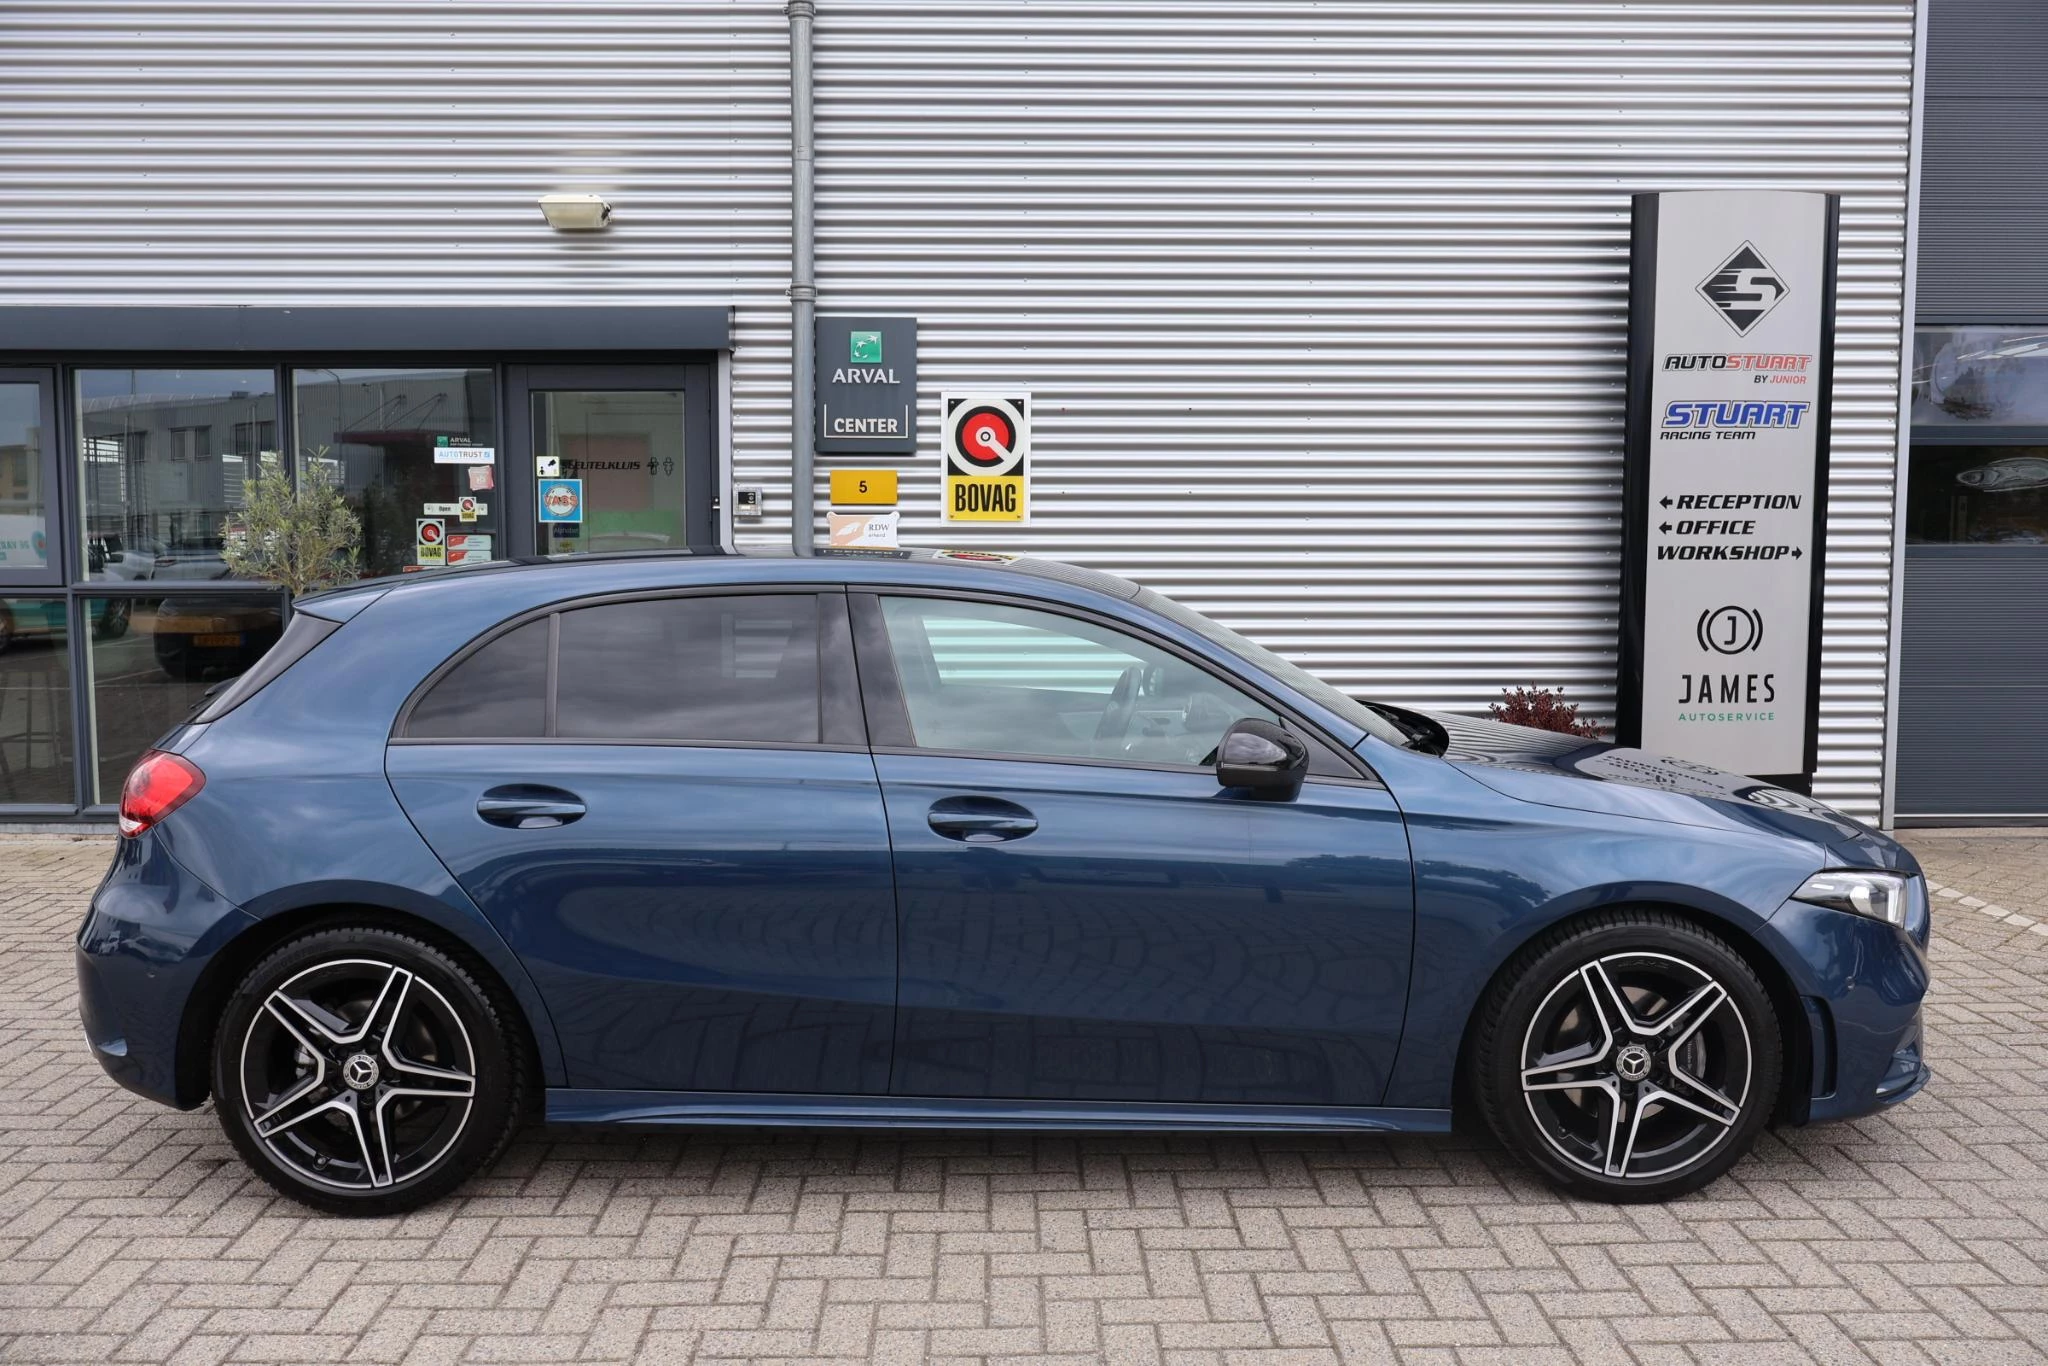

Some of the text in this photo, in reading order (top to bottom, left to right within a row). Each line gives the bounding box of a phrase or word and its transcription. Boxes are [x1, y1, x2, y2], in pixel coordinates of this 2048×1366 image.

[1663, 353, 1812, 371] AUTOSTUART
[832, 368, 900, 384] ARVAL
[1754, 375, 1807, 384] BY JUNIOR
[1662, 400, 1810, 428] STUART
[834, 418, 898, 433] CENTER
[1660, 431, 1756, 440] RACING TEAM
[858, 481, 868, 493] 5
[955, 484, 1017, 512] BOVAG
[1676, 495, 1802, 510] RECEPTION
[868, 523, 890, 532] RDW
[1676, 520, 1756, 535] OFFICE
[421, 546, 442, 558] BOVAG
[1657, 545, 1790, 560] WORKSHOP
[1678, 674, 1776, 703] JAMES
[1678, 712, 1776, 721] AUTOSERVICE
